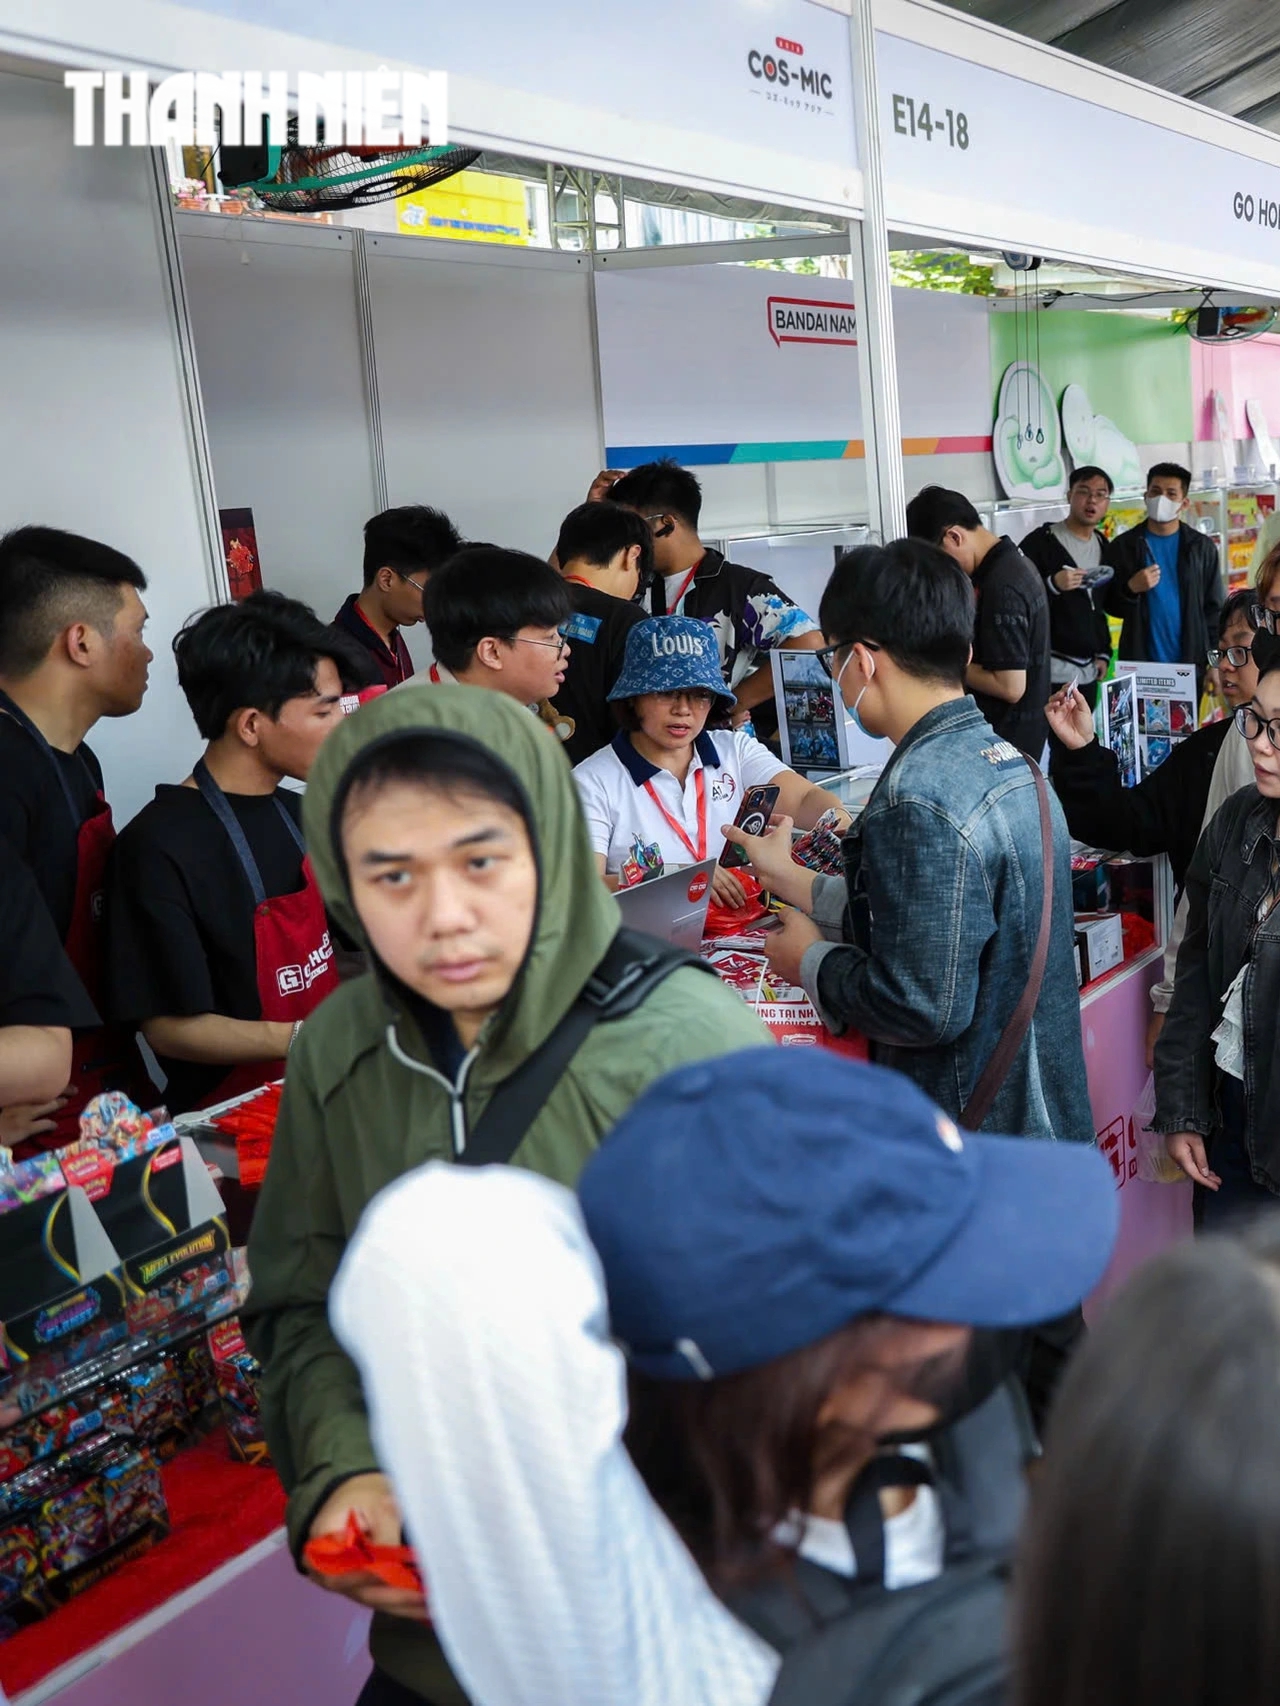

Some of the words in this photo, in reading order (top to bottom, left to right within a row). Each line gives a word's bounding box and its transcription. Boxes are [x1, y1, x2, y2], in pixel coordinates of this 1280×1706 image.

[748, 50, 832, 99] COS-MIC
[892, 93, 969, 150] E14-18
[1233, 191, 1254, 222] GO
[775, 309, 828, 332] BANDAI
[798, 1008, 816, 1018] NH
